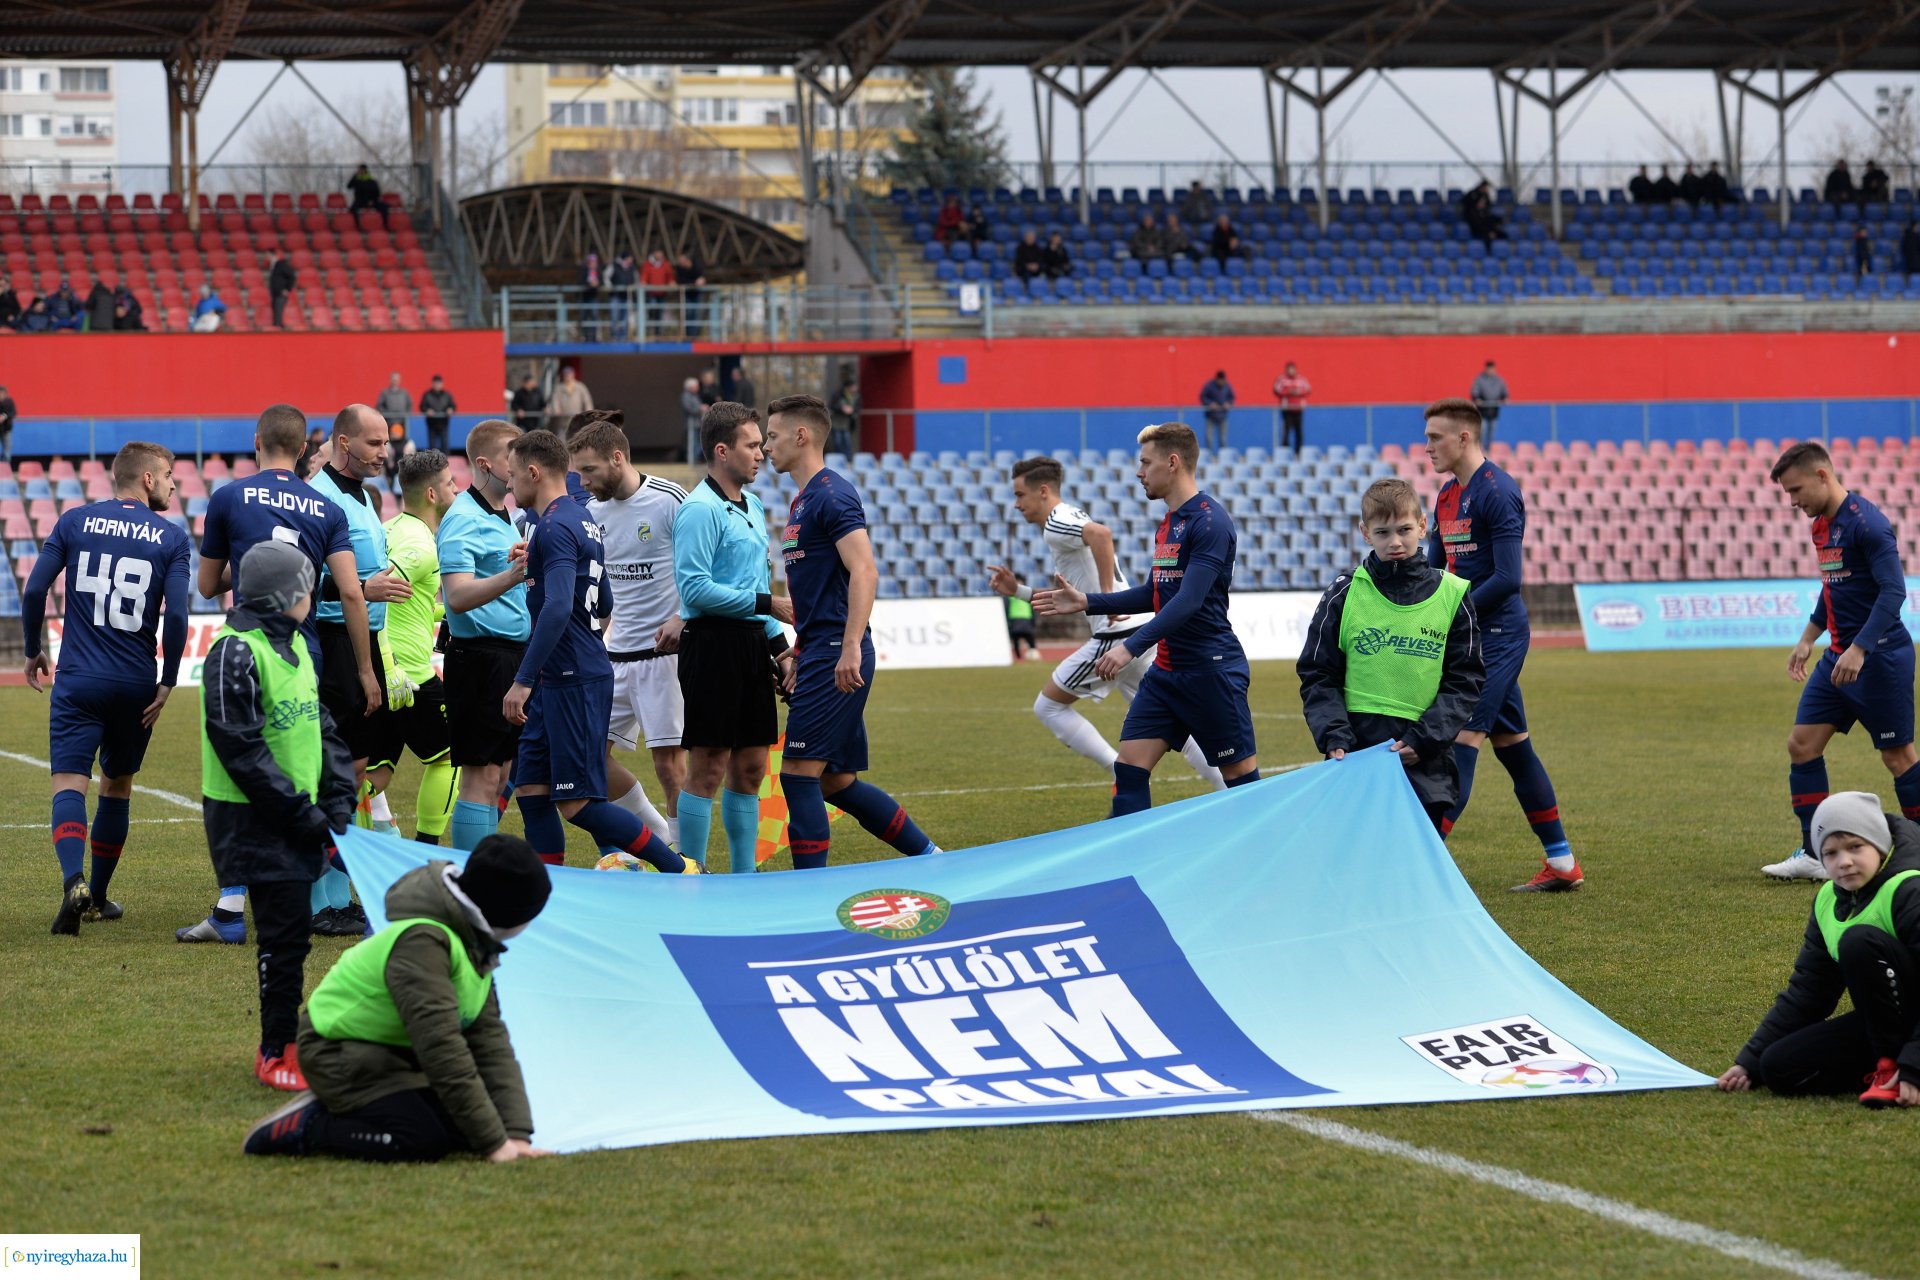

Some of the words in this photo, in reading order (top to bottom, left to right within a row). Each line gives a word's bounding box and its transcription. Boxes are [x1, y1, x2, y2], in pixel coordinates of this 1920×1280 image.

[243, 487, 325, 518] PEJOVIC
[82, 517, 165, 545] HORNYÁK
[75, 550, 153, 633] 48
[1660, 594, 1800, 620] BREKK
[1387, 635, 1444, 654] REVESZ
[788, 741, 806, 749] JAKO
[1217, 748, 1235, 758] JAKO
[555, 782, 575, 791] JAKO
[891, 928, 925, 939] 1901
[765, 974, 817, 1004] A
[816, 935, 1110, 1002] GYŰLÖLET
[777, 973, 1183, 1083] NEM
[1419, 1022, 1546, 1057] FAIR
[1439, 1036, 1558, 1070] PLAY
